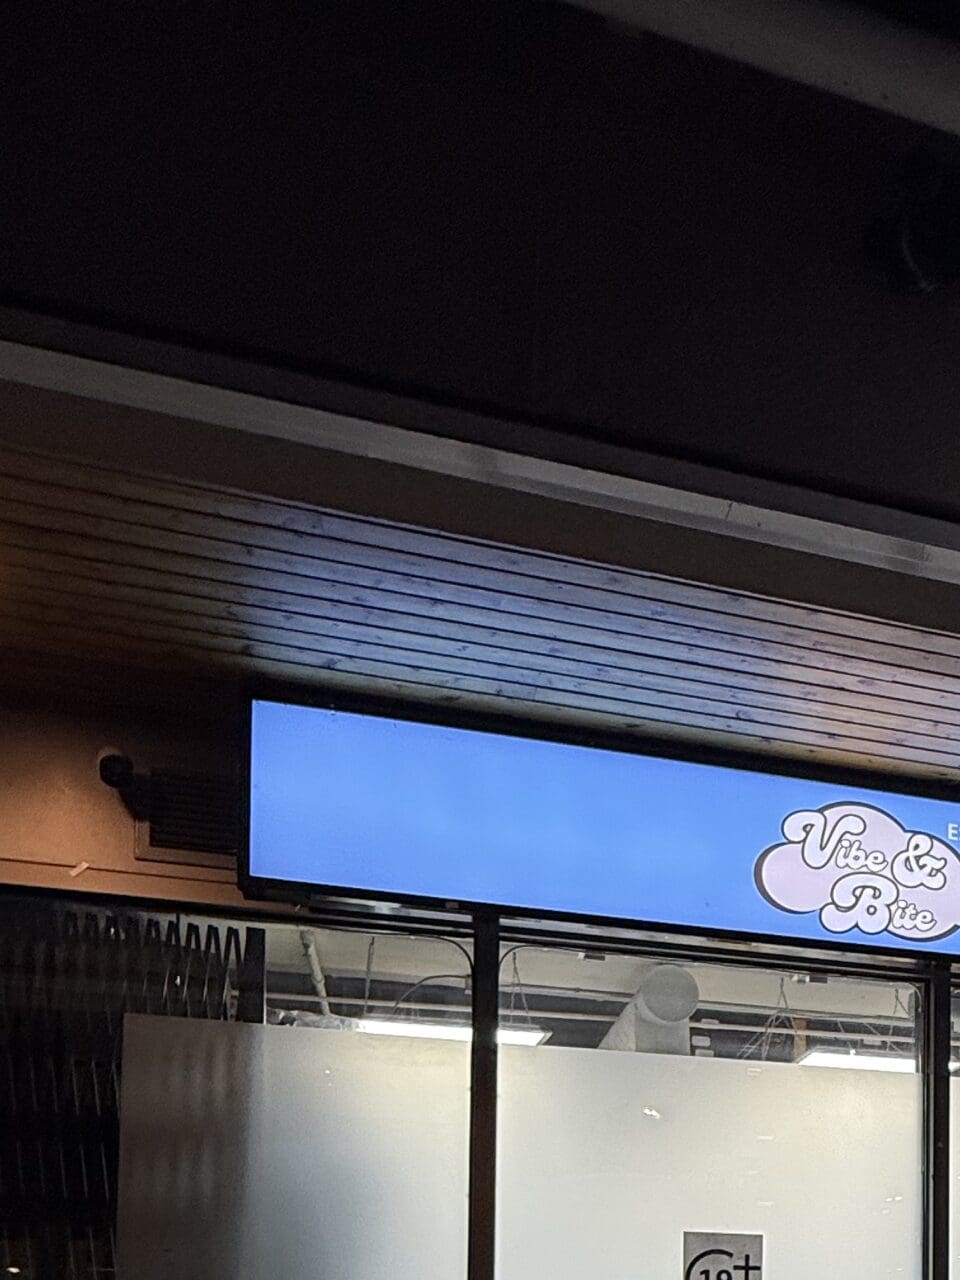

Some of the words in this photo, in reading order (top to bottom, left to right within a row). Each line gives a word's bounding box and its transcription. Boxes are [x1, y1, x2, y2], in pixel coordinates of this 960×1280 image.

[781, 810, 888, 872] Vibe
[891, 834, 947, 890] &
[819, 873, 937, 934] Bite
